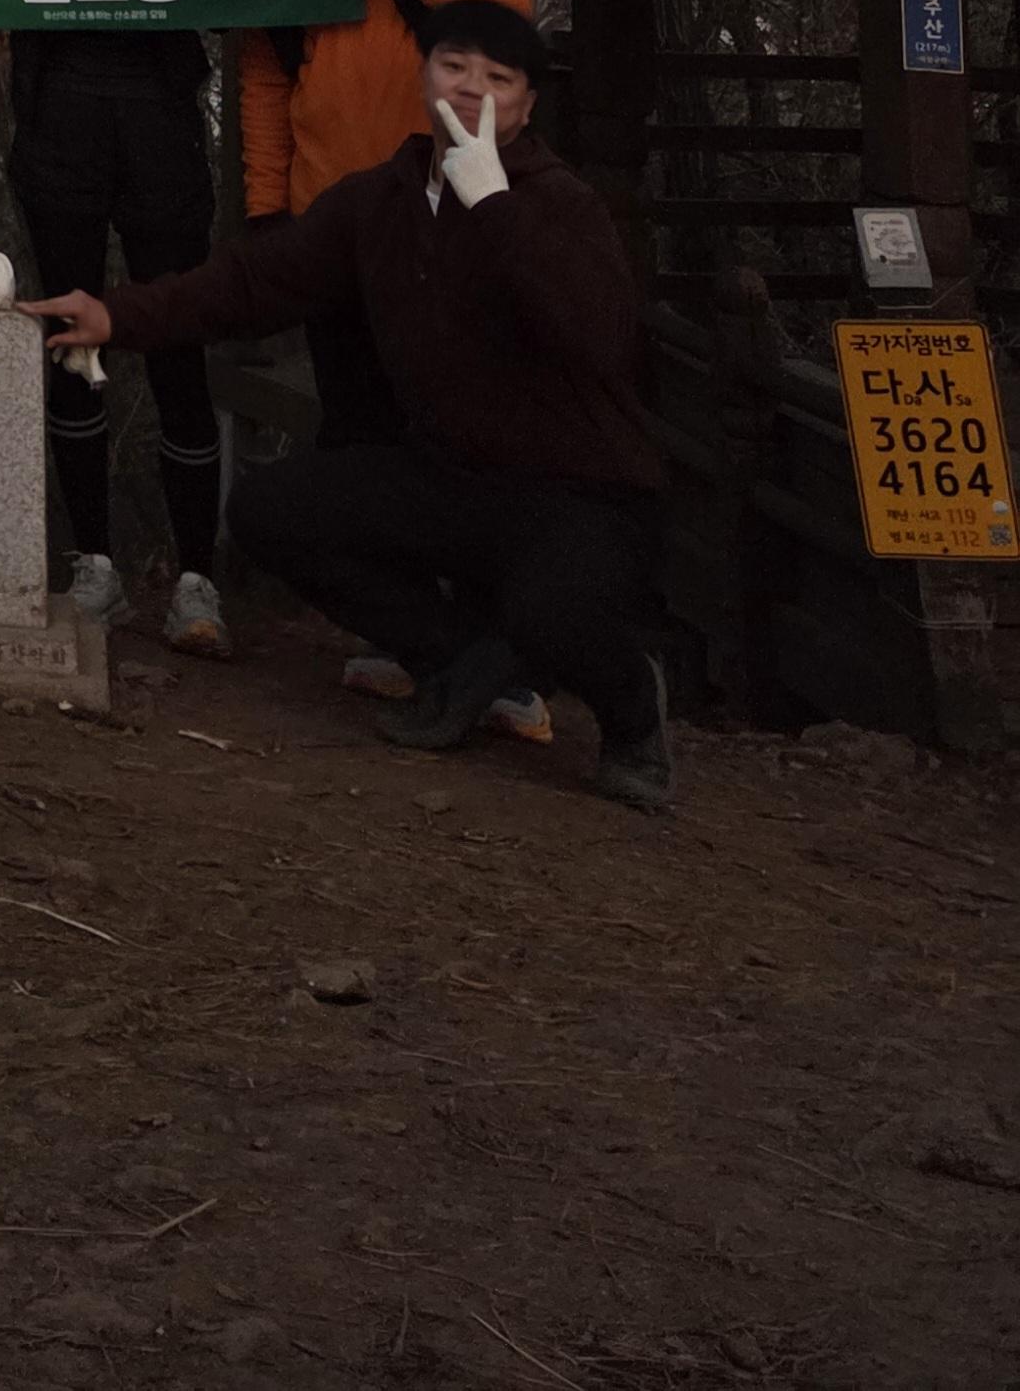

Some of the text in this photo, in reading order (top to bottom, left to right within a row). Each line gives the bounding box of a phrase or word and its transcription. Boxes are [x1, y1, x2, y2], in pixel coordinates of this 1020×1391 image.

[849, 334, 976, 357] 국가지점번호
[870, 416, 986, 455] 3620
[878, 460, 994, 498] 4164
[946, 508, 977, 525] 119
[951, 530, 980, 547] 112
